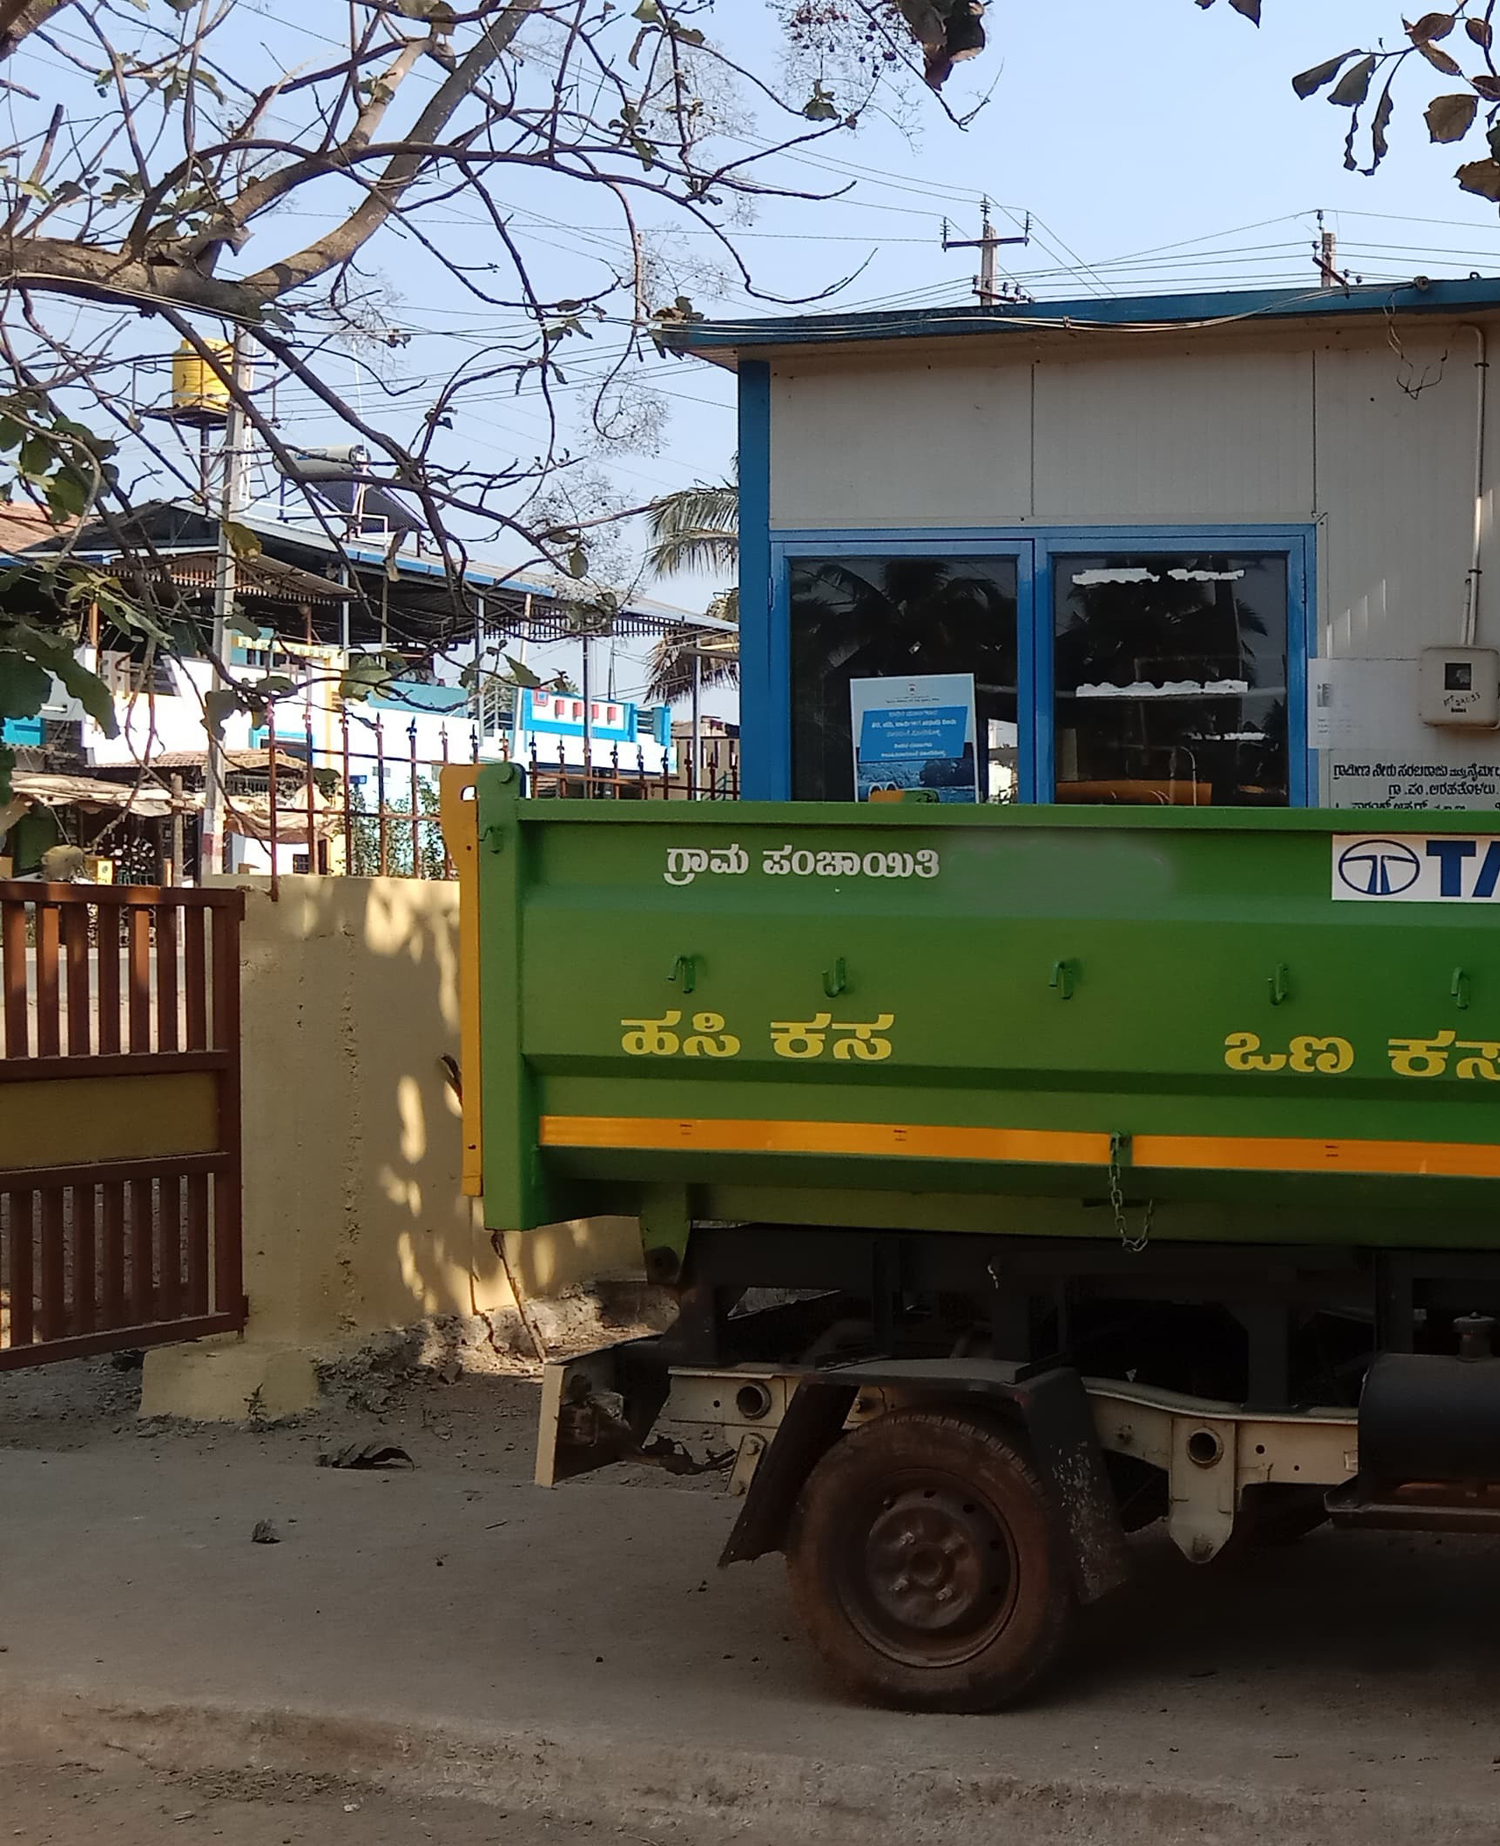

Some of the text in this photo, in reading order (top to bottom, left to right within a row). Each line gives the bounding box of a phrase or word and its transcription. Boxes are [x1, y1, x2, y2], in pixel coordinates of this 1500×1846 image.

[663, 844, 940, 886] ಗ್ರಾಮ ಪಂಚಾಯಿತಿ
[621, 1010, 895, 1061] ಹಸಿ ಕಸ
[1224, 1031, 1355, 1074] ಒಣ
